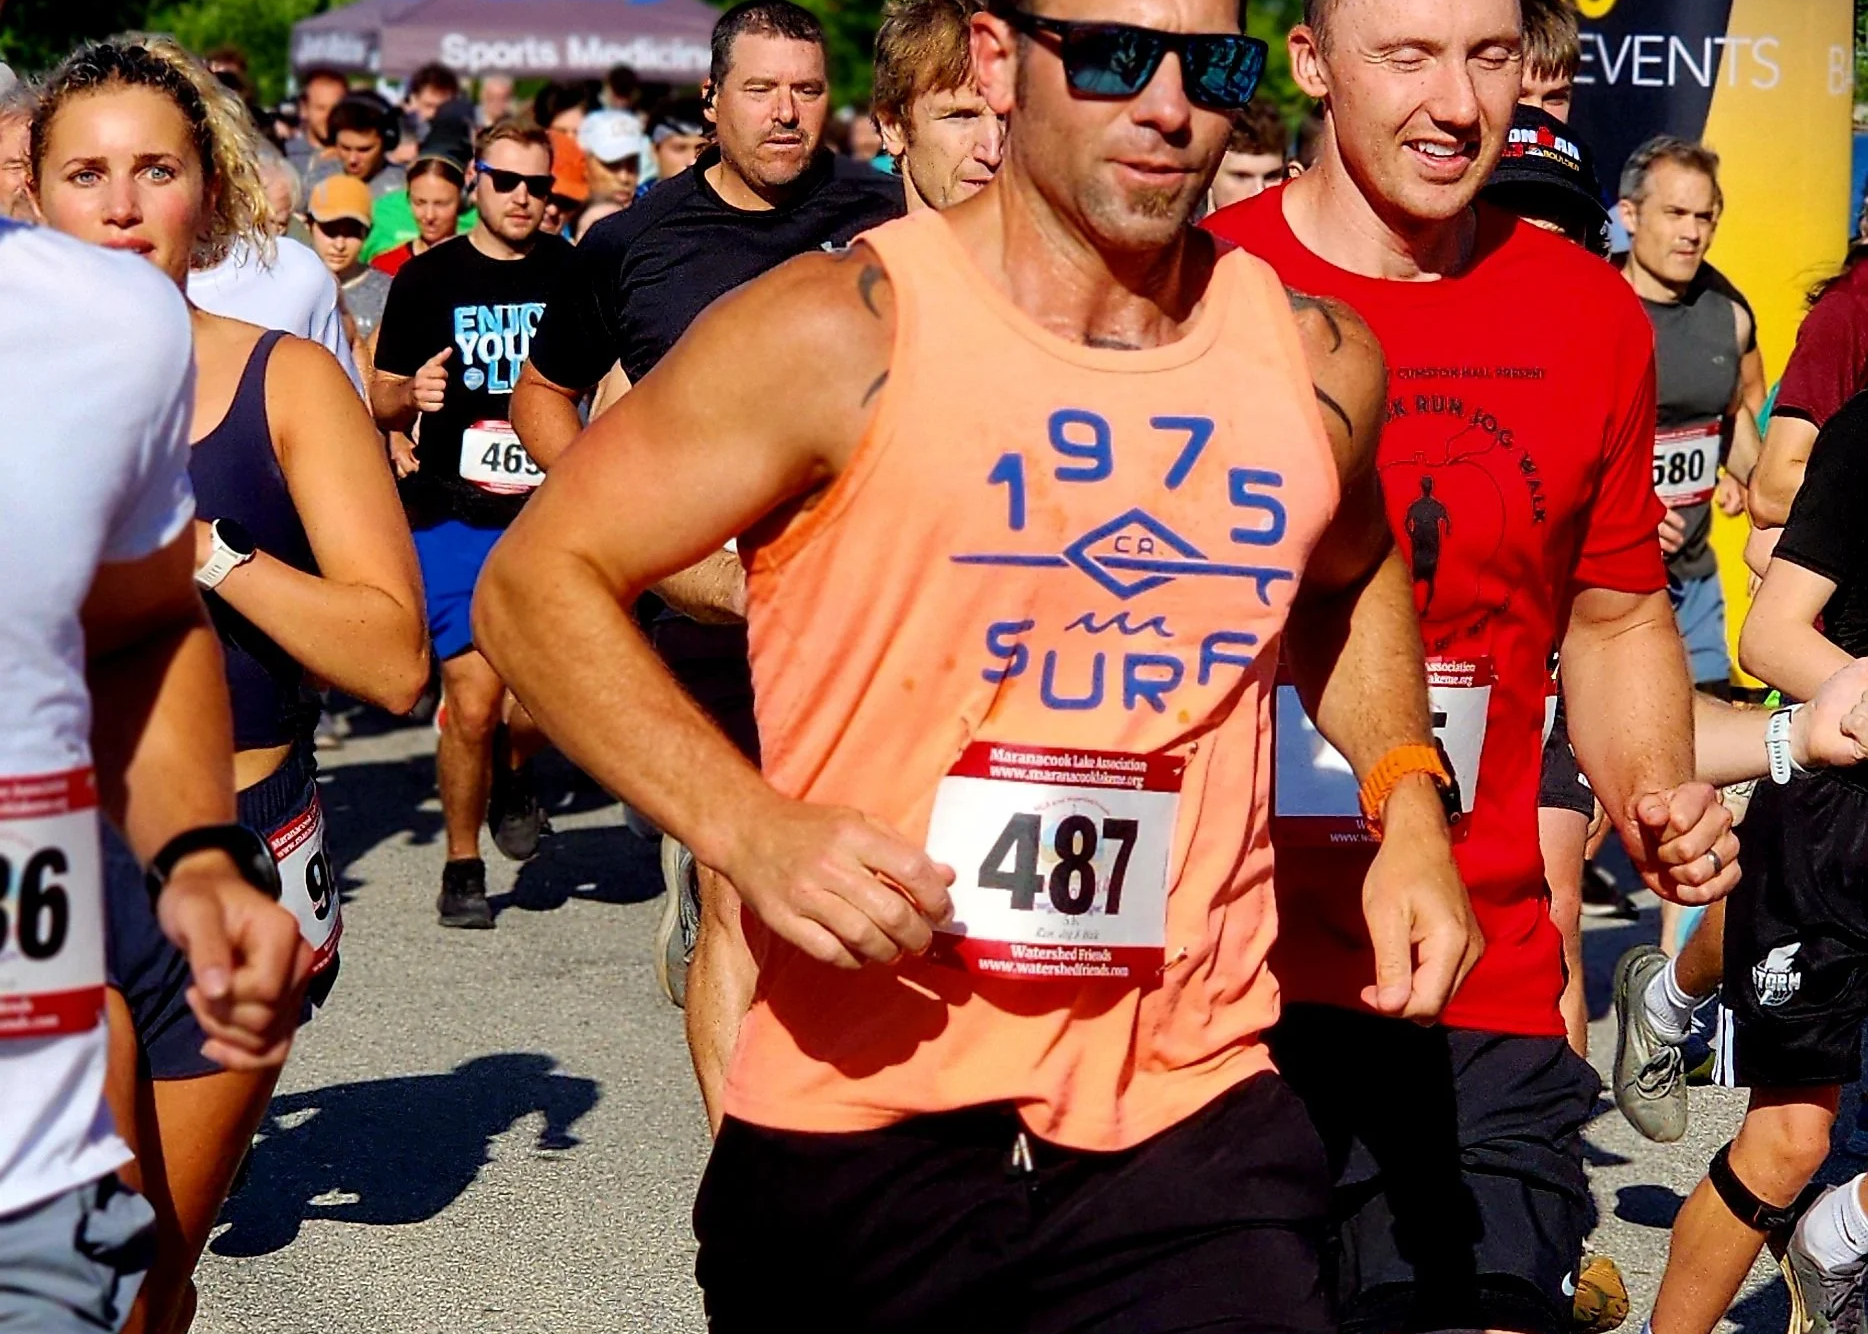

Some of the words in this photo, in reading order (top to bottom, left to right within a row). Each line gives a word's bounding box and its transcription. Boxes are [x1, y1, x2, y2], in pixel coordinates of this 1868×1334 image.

[441, 32, 558, 71] Sports
[1572, 34, 1780, 89] EVENTS
[1828, 44, 1853, 95] B
[455, 330, 529, 365] YOU
[987, 408, 1287, 547] 1975
[1415, 394, 1465, 417] RUN
[1469, 408, 1513, 448] JOG
[1520, 451, 1545, 523] WALK
[1114, 536, 1154, 554] CA
[982, 619, 1258, 713] SURF
[990, 748, 1071, 767] Maranacook
[1073, 754, 1095, 767] Lake
[1097, 755, 1147, 772] Association
[978, 812, 1139, 915] 487
[979, 959, 1130, 977] www.watershedfriends.com
[1011, 944, 1077, 961] Watershed
[1078, 948, 1112, 962] Friends
